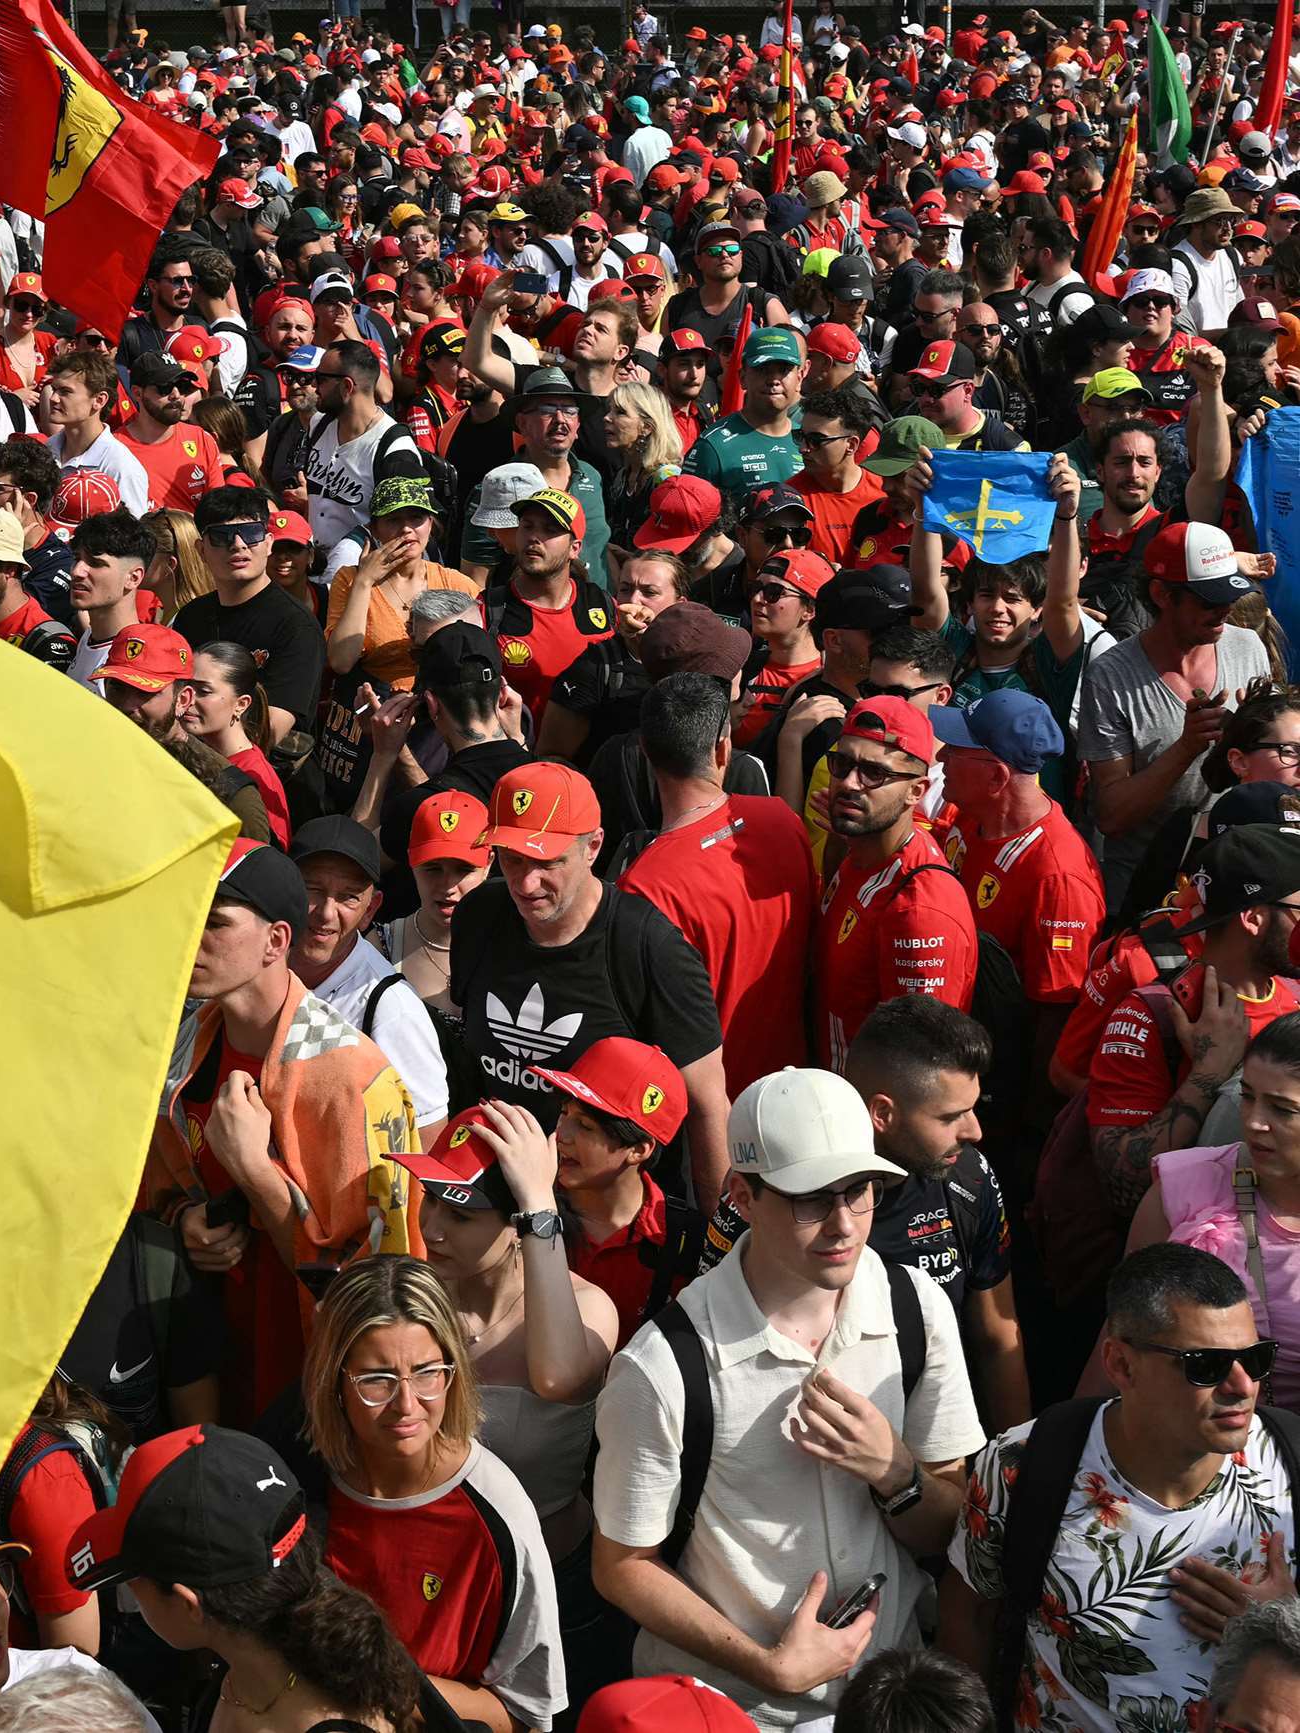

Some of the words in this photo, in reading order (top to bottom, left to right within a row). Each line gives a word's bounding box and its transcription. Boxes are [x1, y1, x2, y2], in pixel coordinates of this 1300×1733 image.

[1040, 918, 1087, 931] kaspersky
[894, 937, 944, 949] HUBLOT
[895, 956, 945, 971] kaspersky
[897, 976, 945, 988] WEICHAI
[1104, 1021, 1149, 1042] MAHLE
[1101, 1042, 1146, 1058] PIRELLI
[69, 1540, 95, 1578] 16
